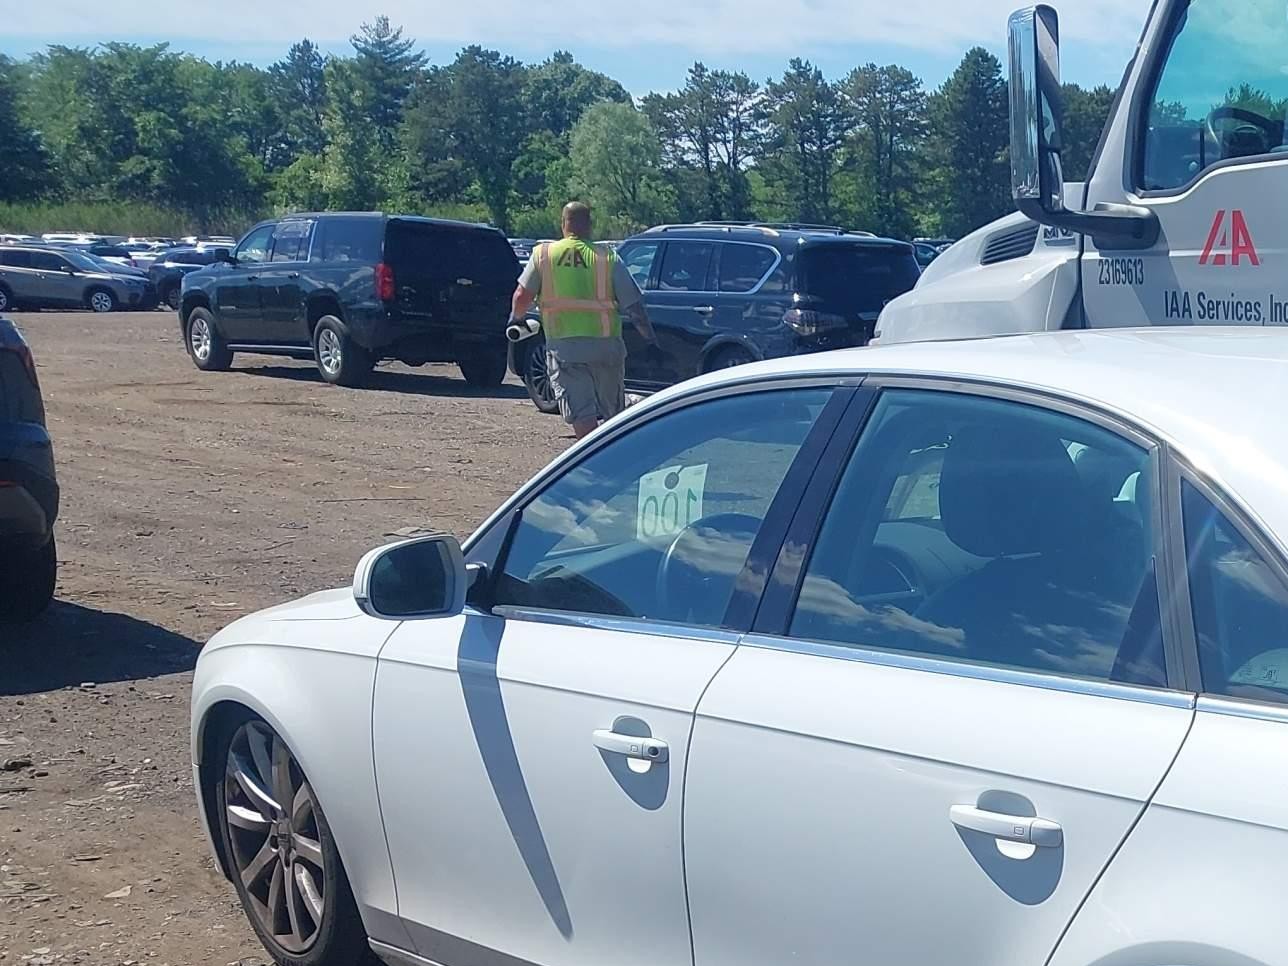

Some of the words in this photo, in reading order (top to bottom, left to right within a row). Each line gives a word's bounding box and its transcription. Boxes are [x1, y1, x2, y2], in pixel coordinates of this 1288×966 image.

[1098, 258, 1144, 285] 23169613
[1164, 290, 1192, 319] IAA
[1197, 291, 1266, 326] Services,
